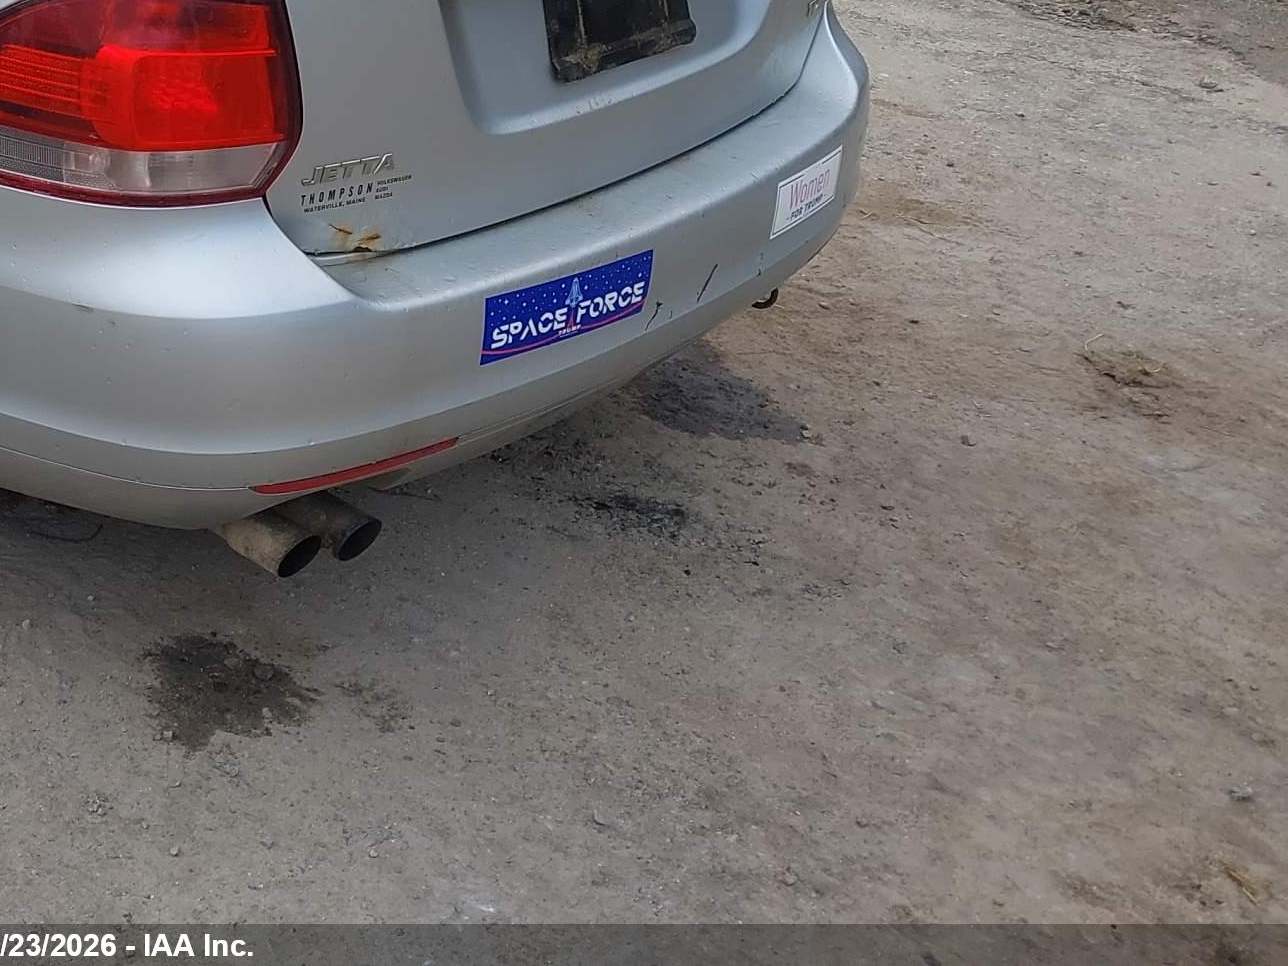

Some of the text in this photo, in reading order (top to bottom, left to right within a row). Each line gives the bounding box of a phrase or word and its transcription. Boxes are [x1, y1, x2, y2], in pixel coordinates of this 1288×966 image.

[300, 153, 394, 186] JETTA
[300, 182, 374, 206] THOMPSON
[374, 192, 393, 201] MAZDA
[790, 170, 830, 209] Women
[303, 196, 367, 213] WATERVILLE, MAINE
[490, 281, 646, 350] SPACE FORCE
